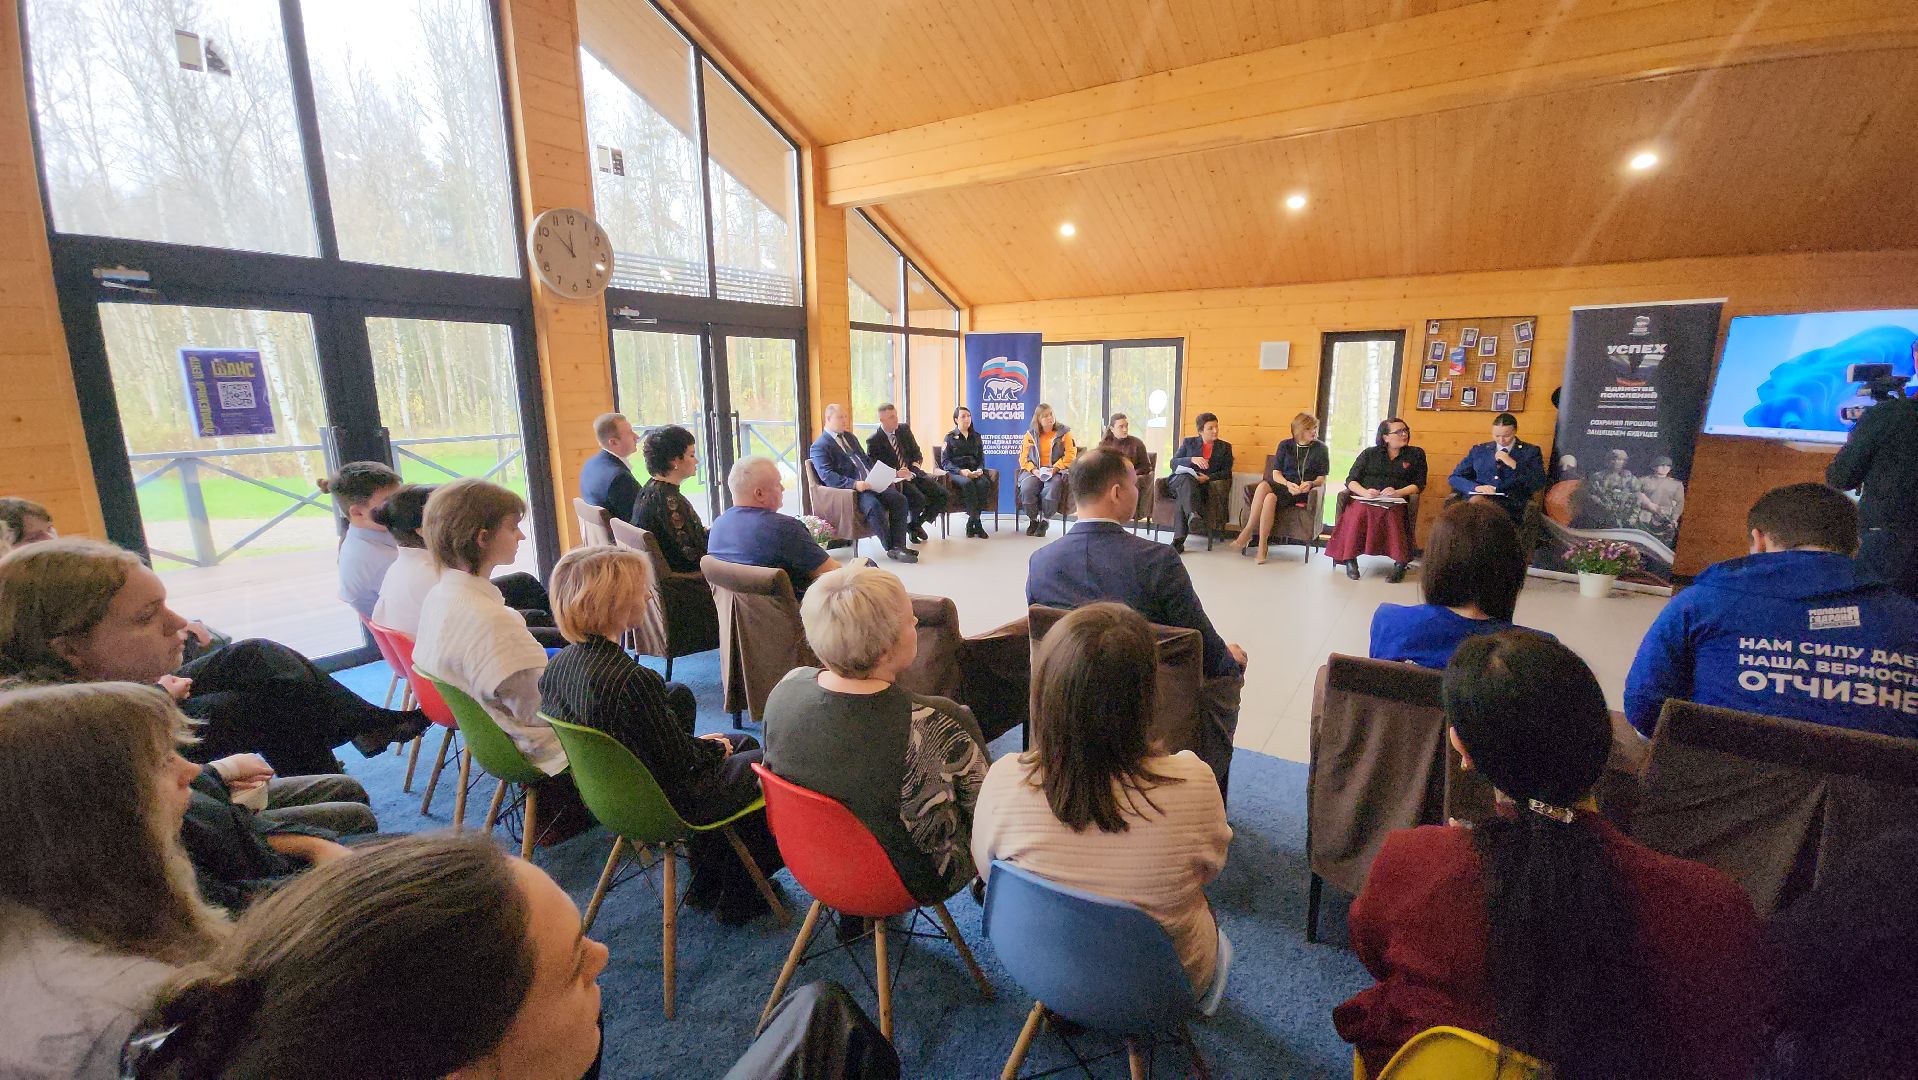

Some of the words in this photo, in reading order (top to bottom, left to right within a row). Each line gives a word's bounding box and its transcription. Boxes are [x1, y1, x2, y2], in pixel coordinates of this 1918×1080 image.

[552, 216, 559, 226] 11
[566, 215, 575, 225] 12
[538, 226, 550, 237] 10
[594, 235, 600, 246] 2
[536, 243, 543, 254] 9
[600, 253, 606, 262] 3
[543, 262, 550, 272] 8
[556, 275, 562, 284] 7
[586, 278, 592, 288] 5
[572, 283, 578, 292] 6
[1607, 343, 1668, 355] УСПЕХ
[1600, 391, 1658, 399] ПОКОЛЕНИЙ
[981, 402, 1025, 411] ЕДИНАЯ
[981, 411, 1025, 420] РОССИЯ
[1739, 637, 1792, 652] НАМ
[1799, 642, 1865, 659] СИЛУ
[1739, 653, 1810, 671] НАША
[1738, 670, 1918, 714] ОТЧИЗНЕ
